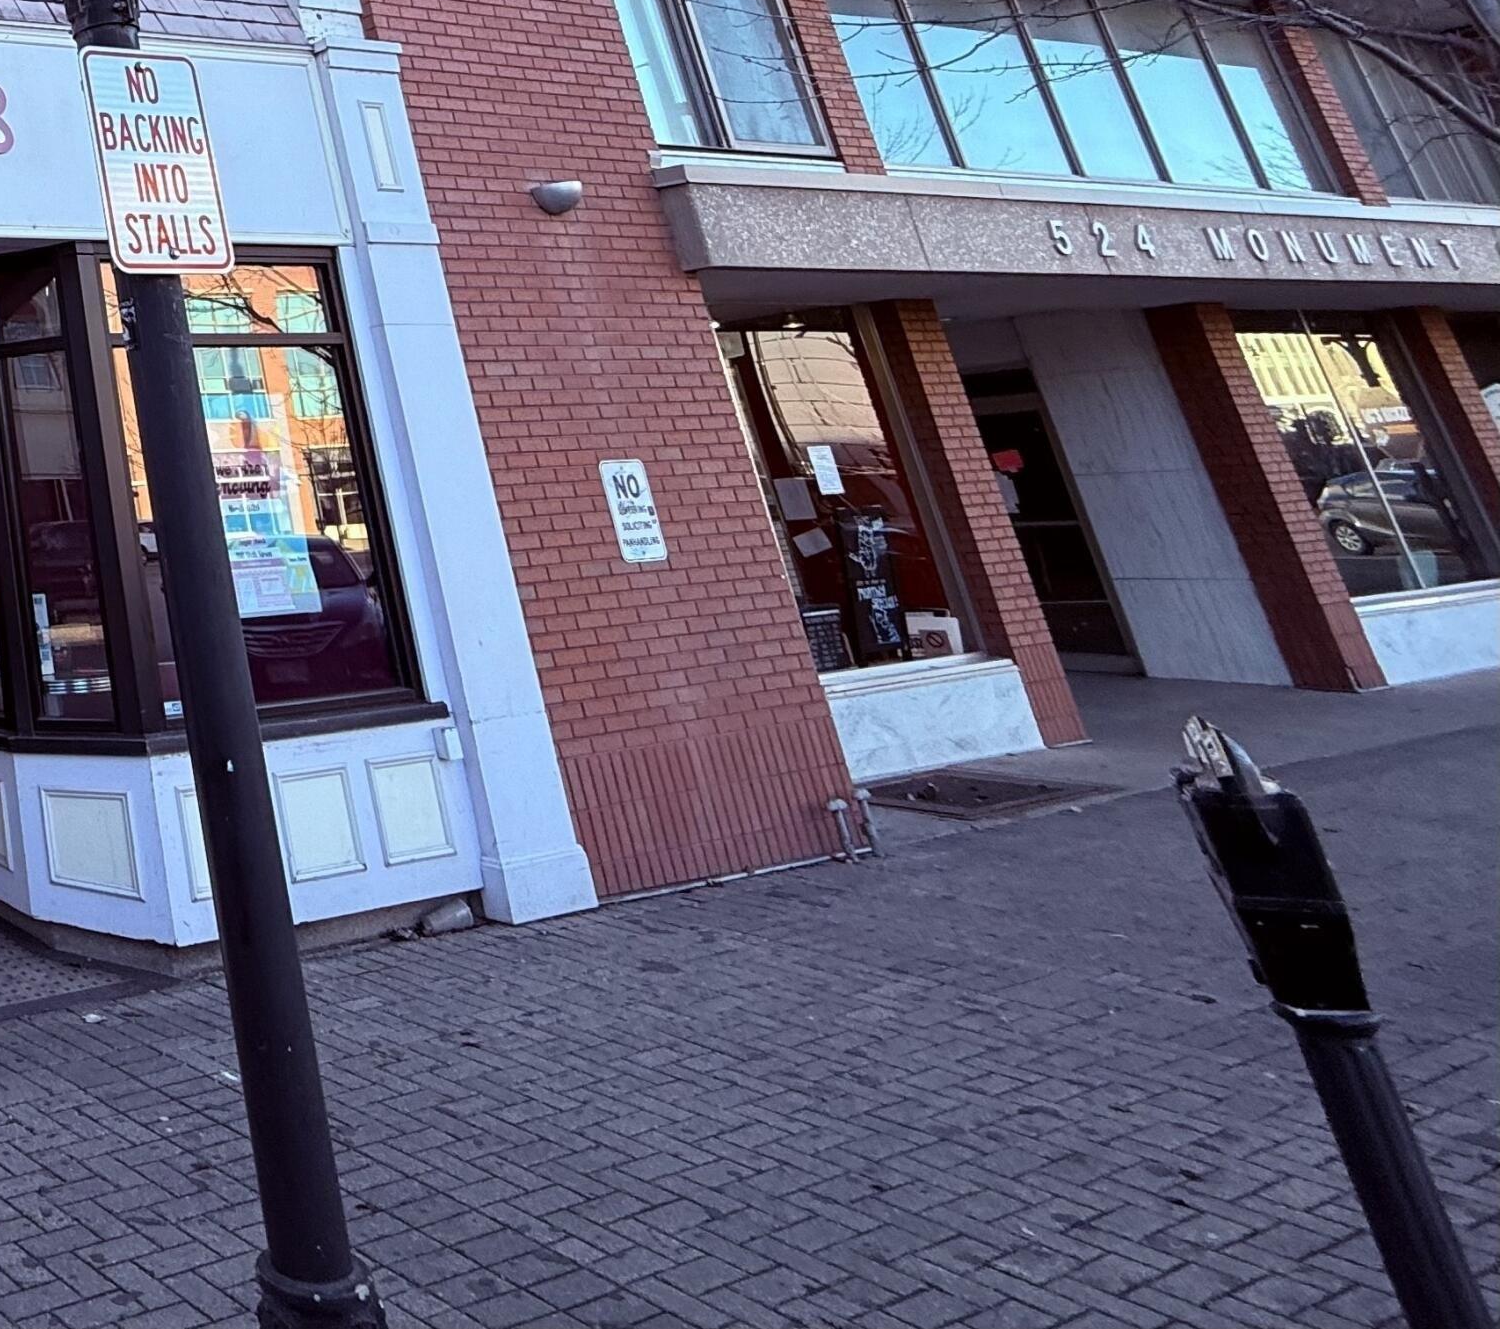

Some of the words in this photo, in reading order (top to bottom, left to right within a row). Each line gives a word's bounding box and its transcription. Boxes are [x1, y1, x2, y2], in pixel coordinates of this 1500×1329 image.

[124, 63, 159, 104] NO
[99, 112, 204, 155] BACKING
[134, 162, 188, 204] INTO
[125, 213, 216, 255] STALLS
[1047, 220, 1156, 259] 524
[1203, 226, 1461, 269] MONUMENT
[612, 473, 640, 499] NO
